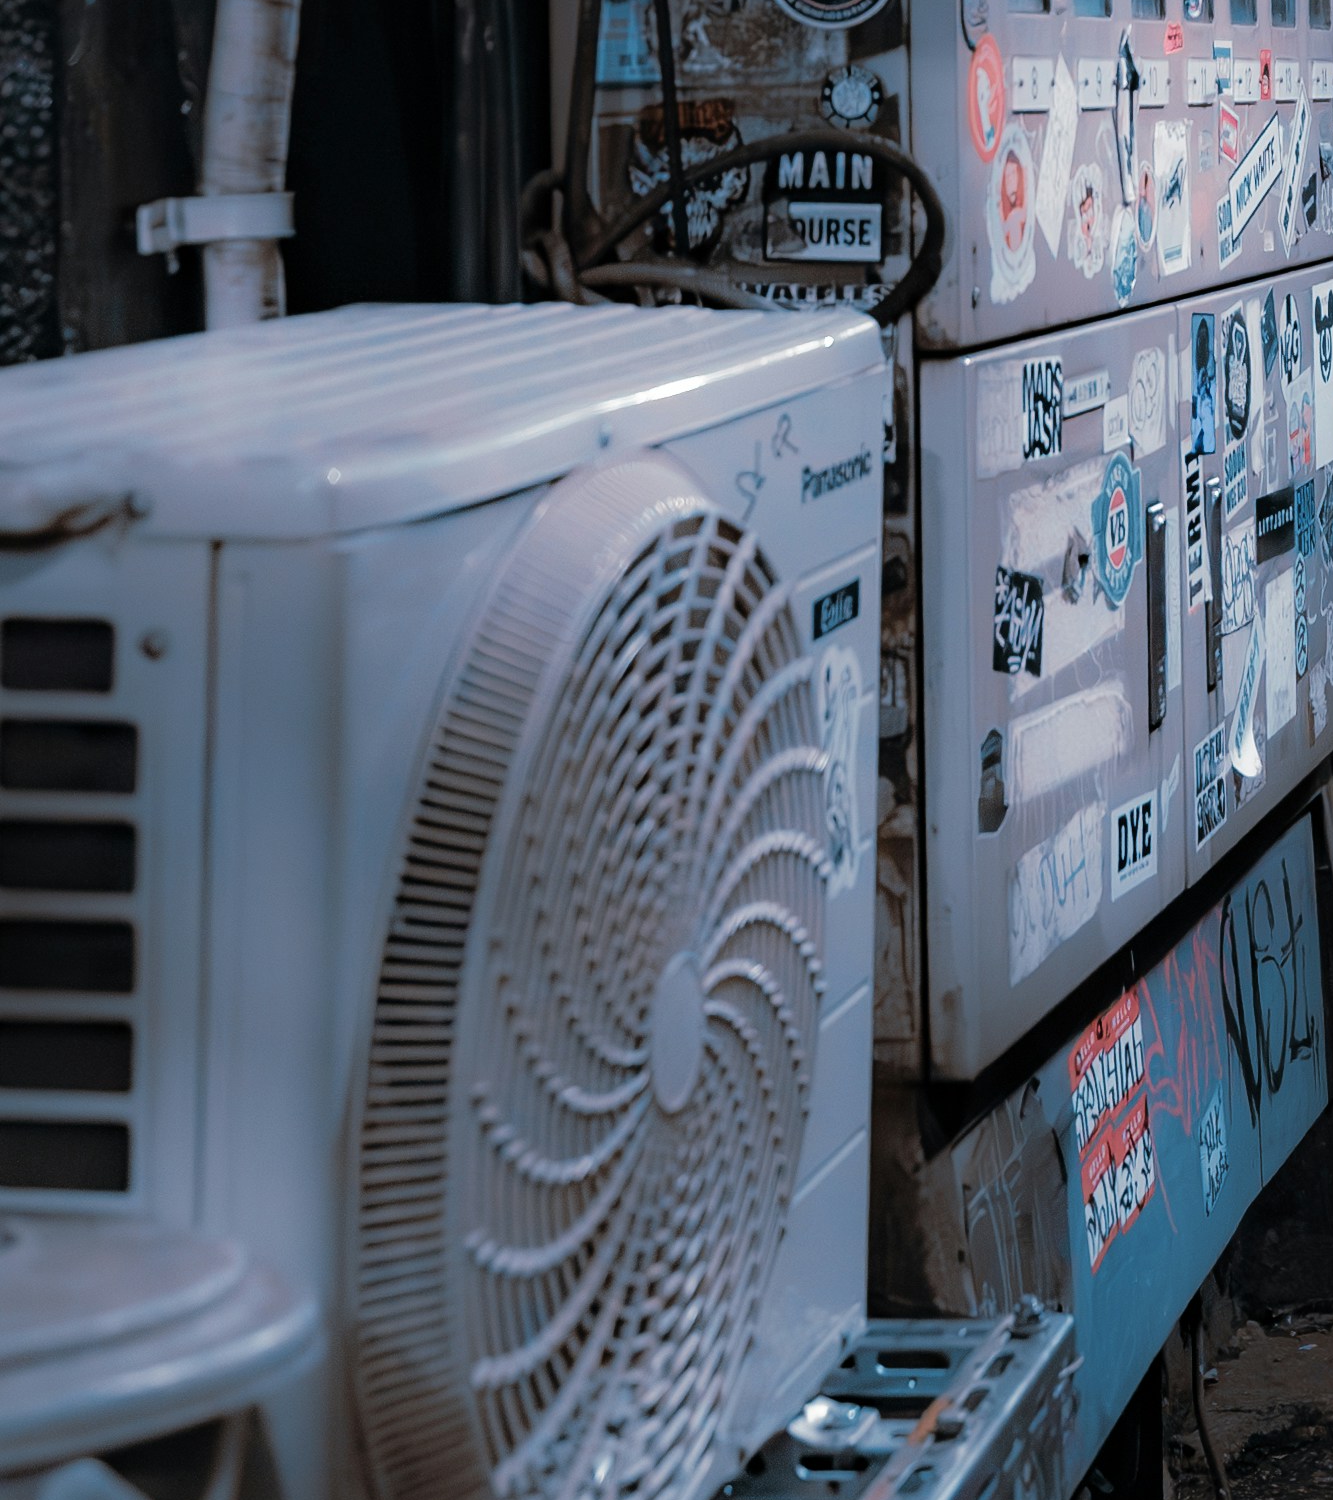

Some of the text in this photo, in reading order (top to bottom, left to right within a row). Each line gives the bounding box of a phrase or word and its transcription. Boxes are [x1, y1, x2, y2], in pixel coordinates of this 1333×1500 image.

[778, 151, 873, 191] MAIN
[802, 450, 871, 503] Panasonic
[1110, 509, 1126, 547] VB
[1111, 998, 1132, 1028] HELLO
[1088, 1143, 1106, 1180] HELLO
